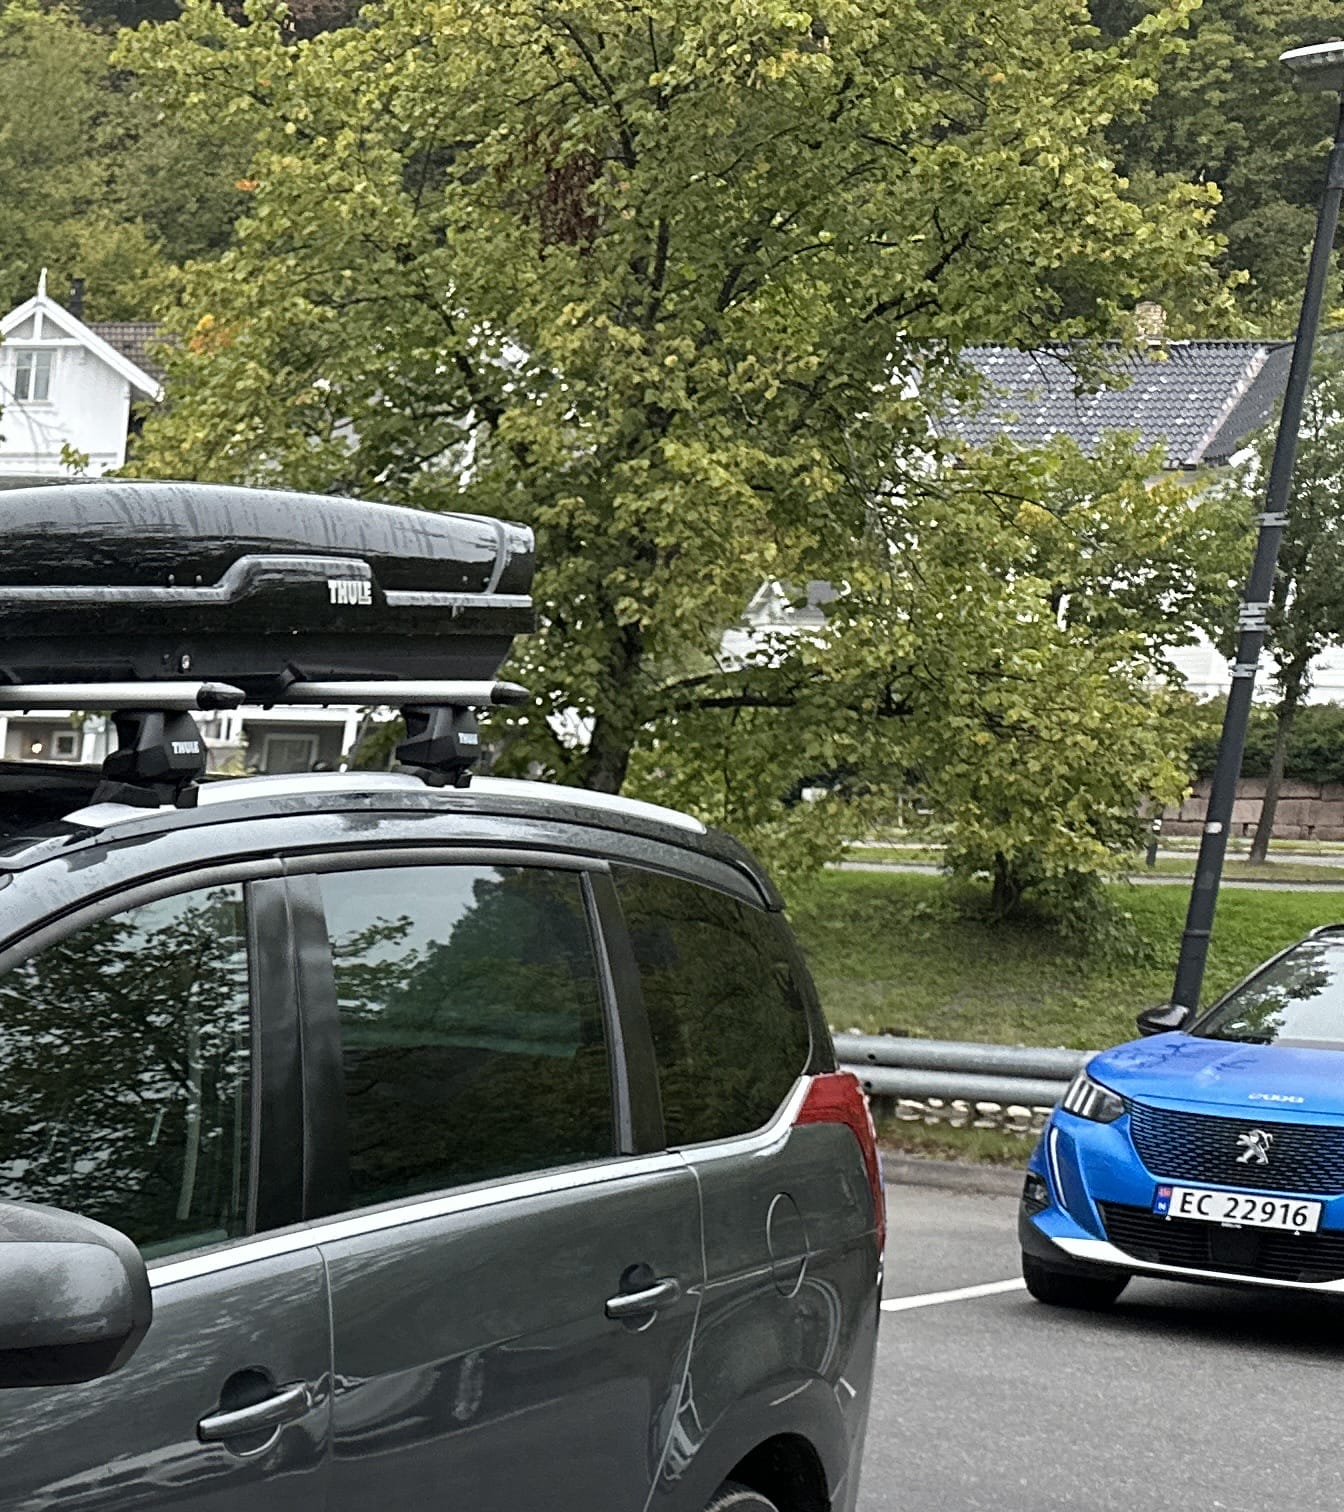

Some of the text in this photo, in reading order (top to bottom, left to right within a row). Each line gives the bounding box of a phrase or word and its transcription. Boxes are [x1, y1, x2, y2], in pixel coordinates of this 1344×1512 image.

[328, 580, 372, 605] THULE
[1179, 1192, 1309, 1227] EC 22916
